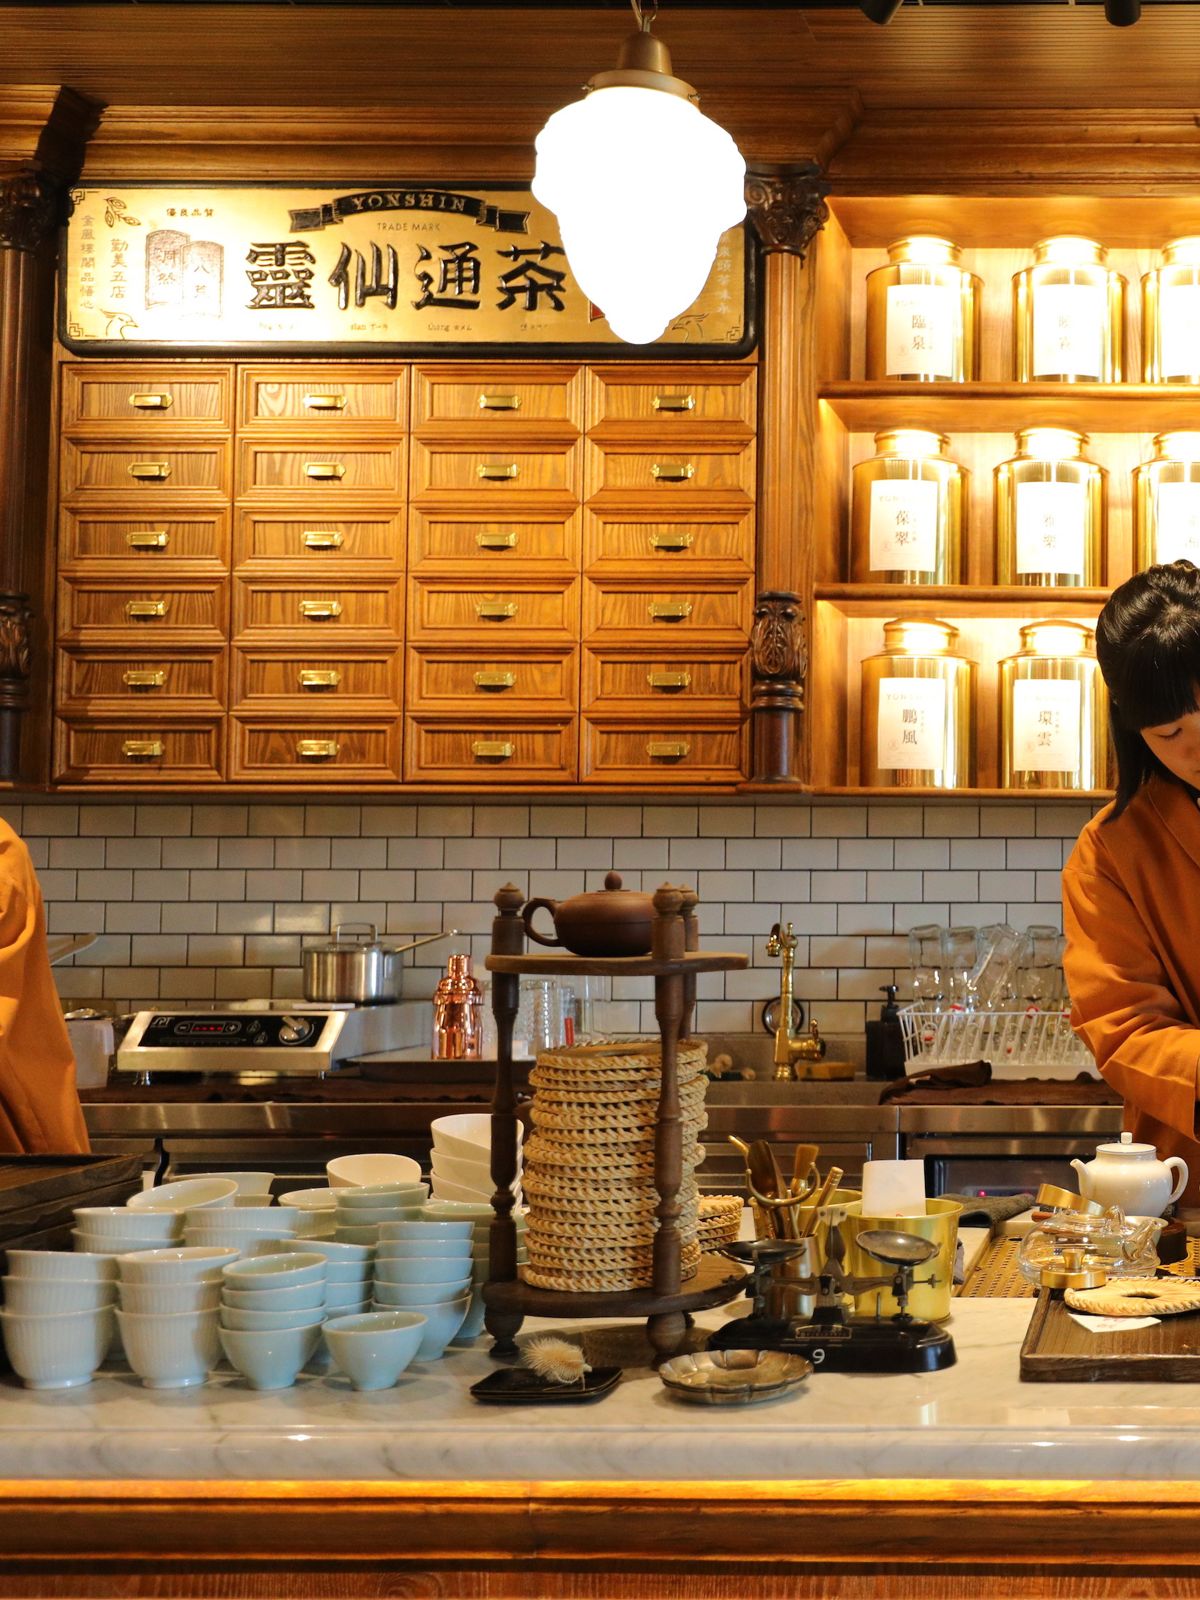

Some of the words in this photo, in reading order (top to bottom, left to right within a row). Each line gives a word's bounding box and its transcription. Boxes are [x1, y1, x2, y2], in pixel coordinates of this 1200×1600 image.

[351, 192, 467, 211] YONSHIN
[377, 222, 408, 231] TRADE
[412, 222, 441, 231] MARK
[245, 240, 567, 312] 靈仙通茶
[812, 1348, 826, 1364] 9
